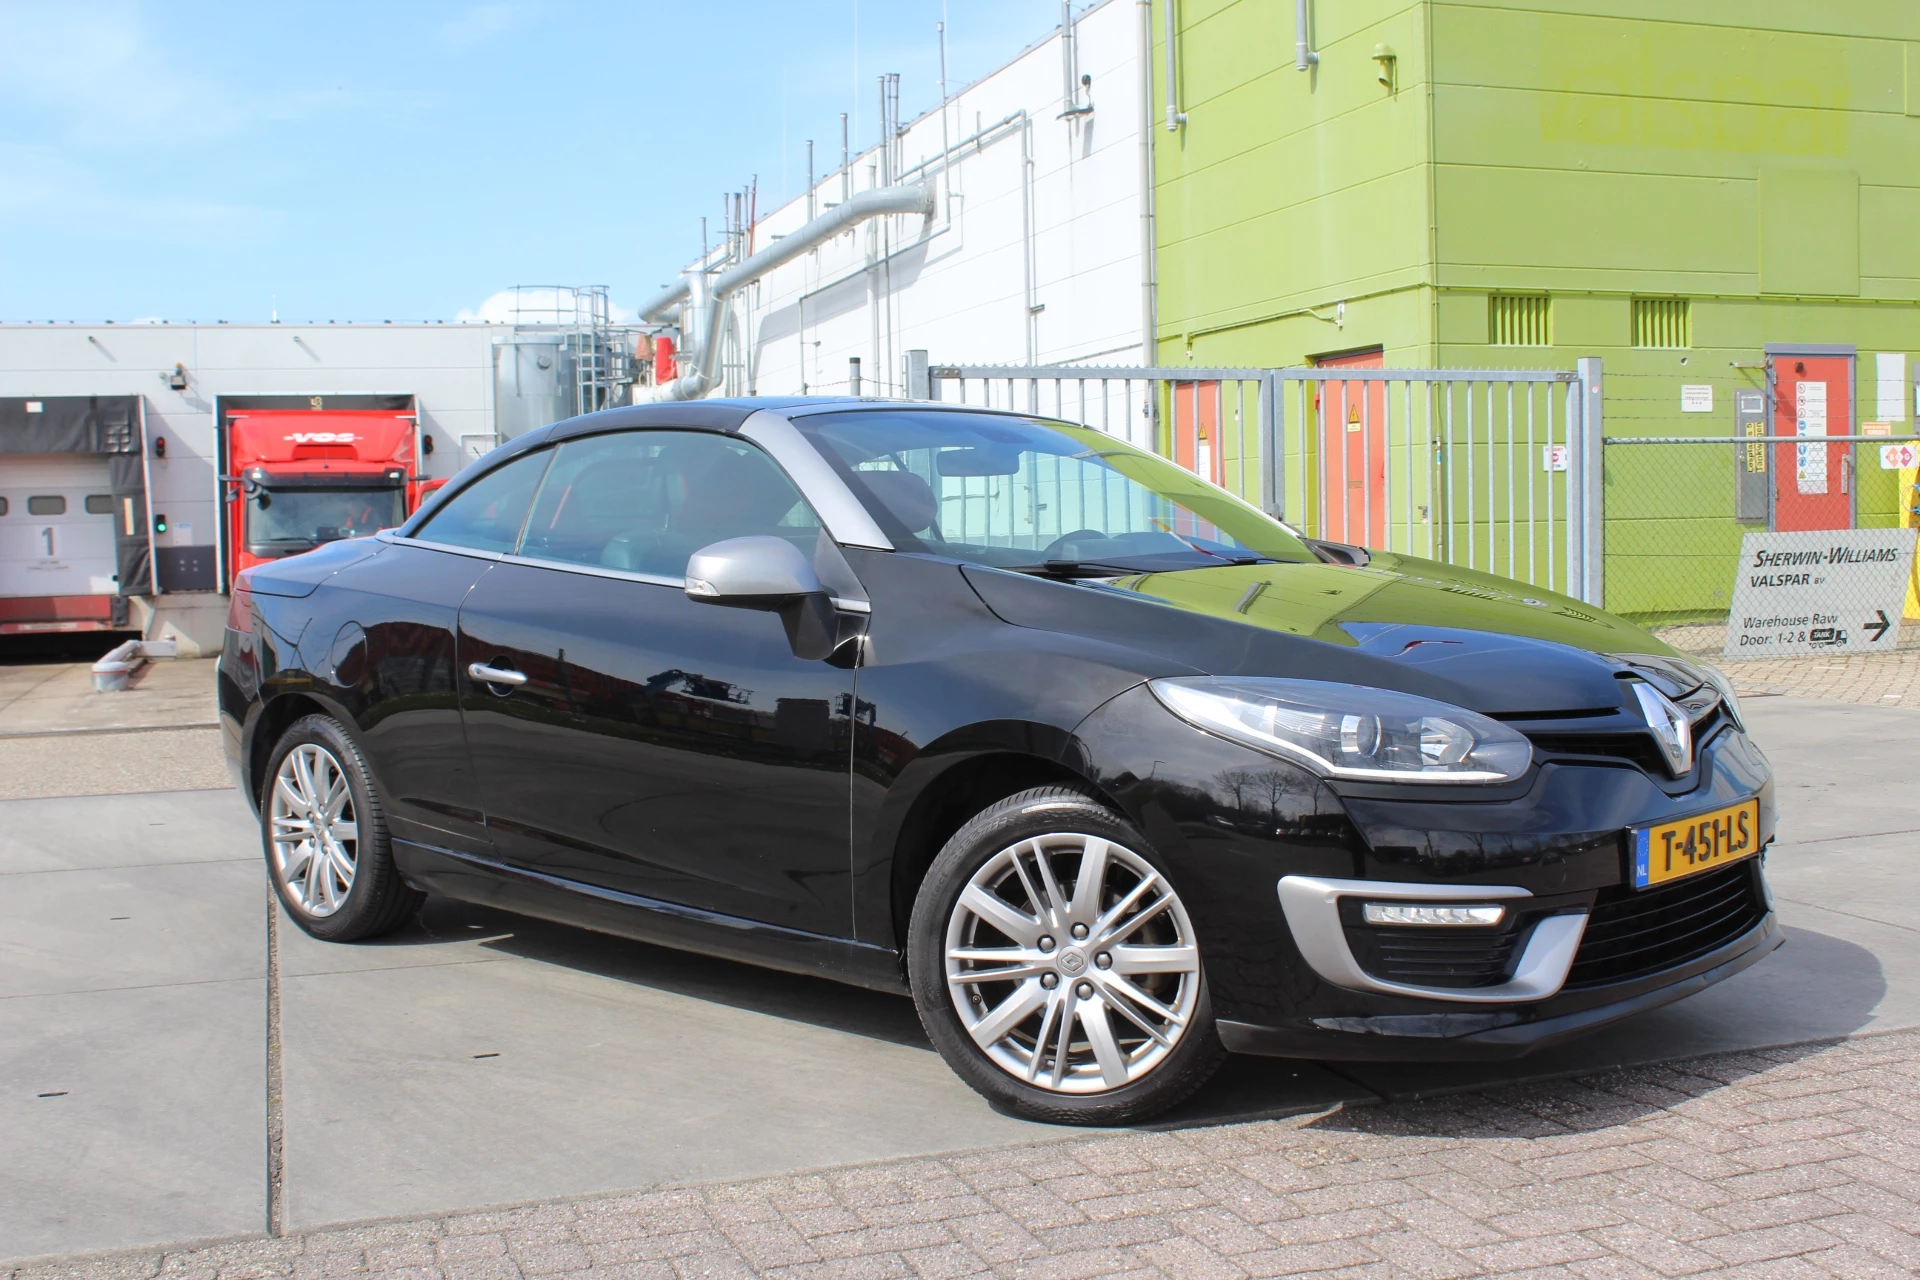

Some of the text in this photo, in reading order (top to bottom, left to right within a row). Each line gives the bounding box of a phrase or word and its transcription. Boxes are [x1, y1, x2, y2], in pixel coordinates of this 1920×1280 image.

[42, 527, 54, 556] 1
[1751, 573, 1810, 588] VALSPAR
[1743, 613, 1839, 629] Warehouse Raw
[1740, 634, 1773, 646] Door:
[1777, 631, 1795, 644] 1-2
[1797, 631, 1807, 643] &
[1661, 811, 1749, 871] T-451-LS
[1636, 864, 1647, 876] NL
